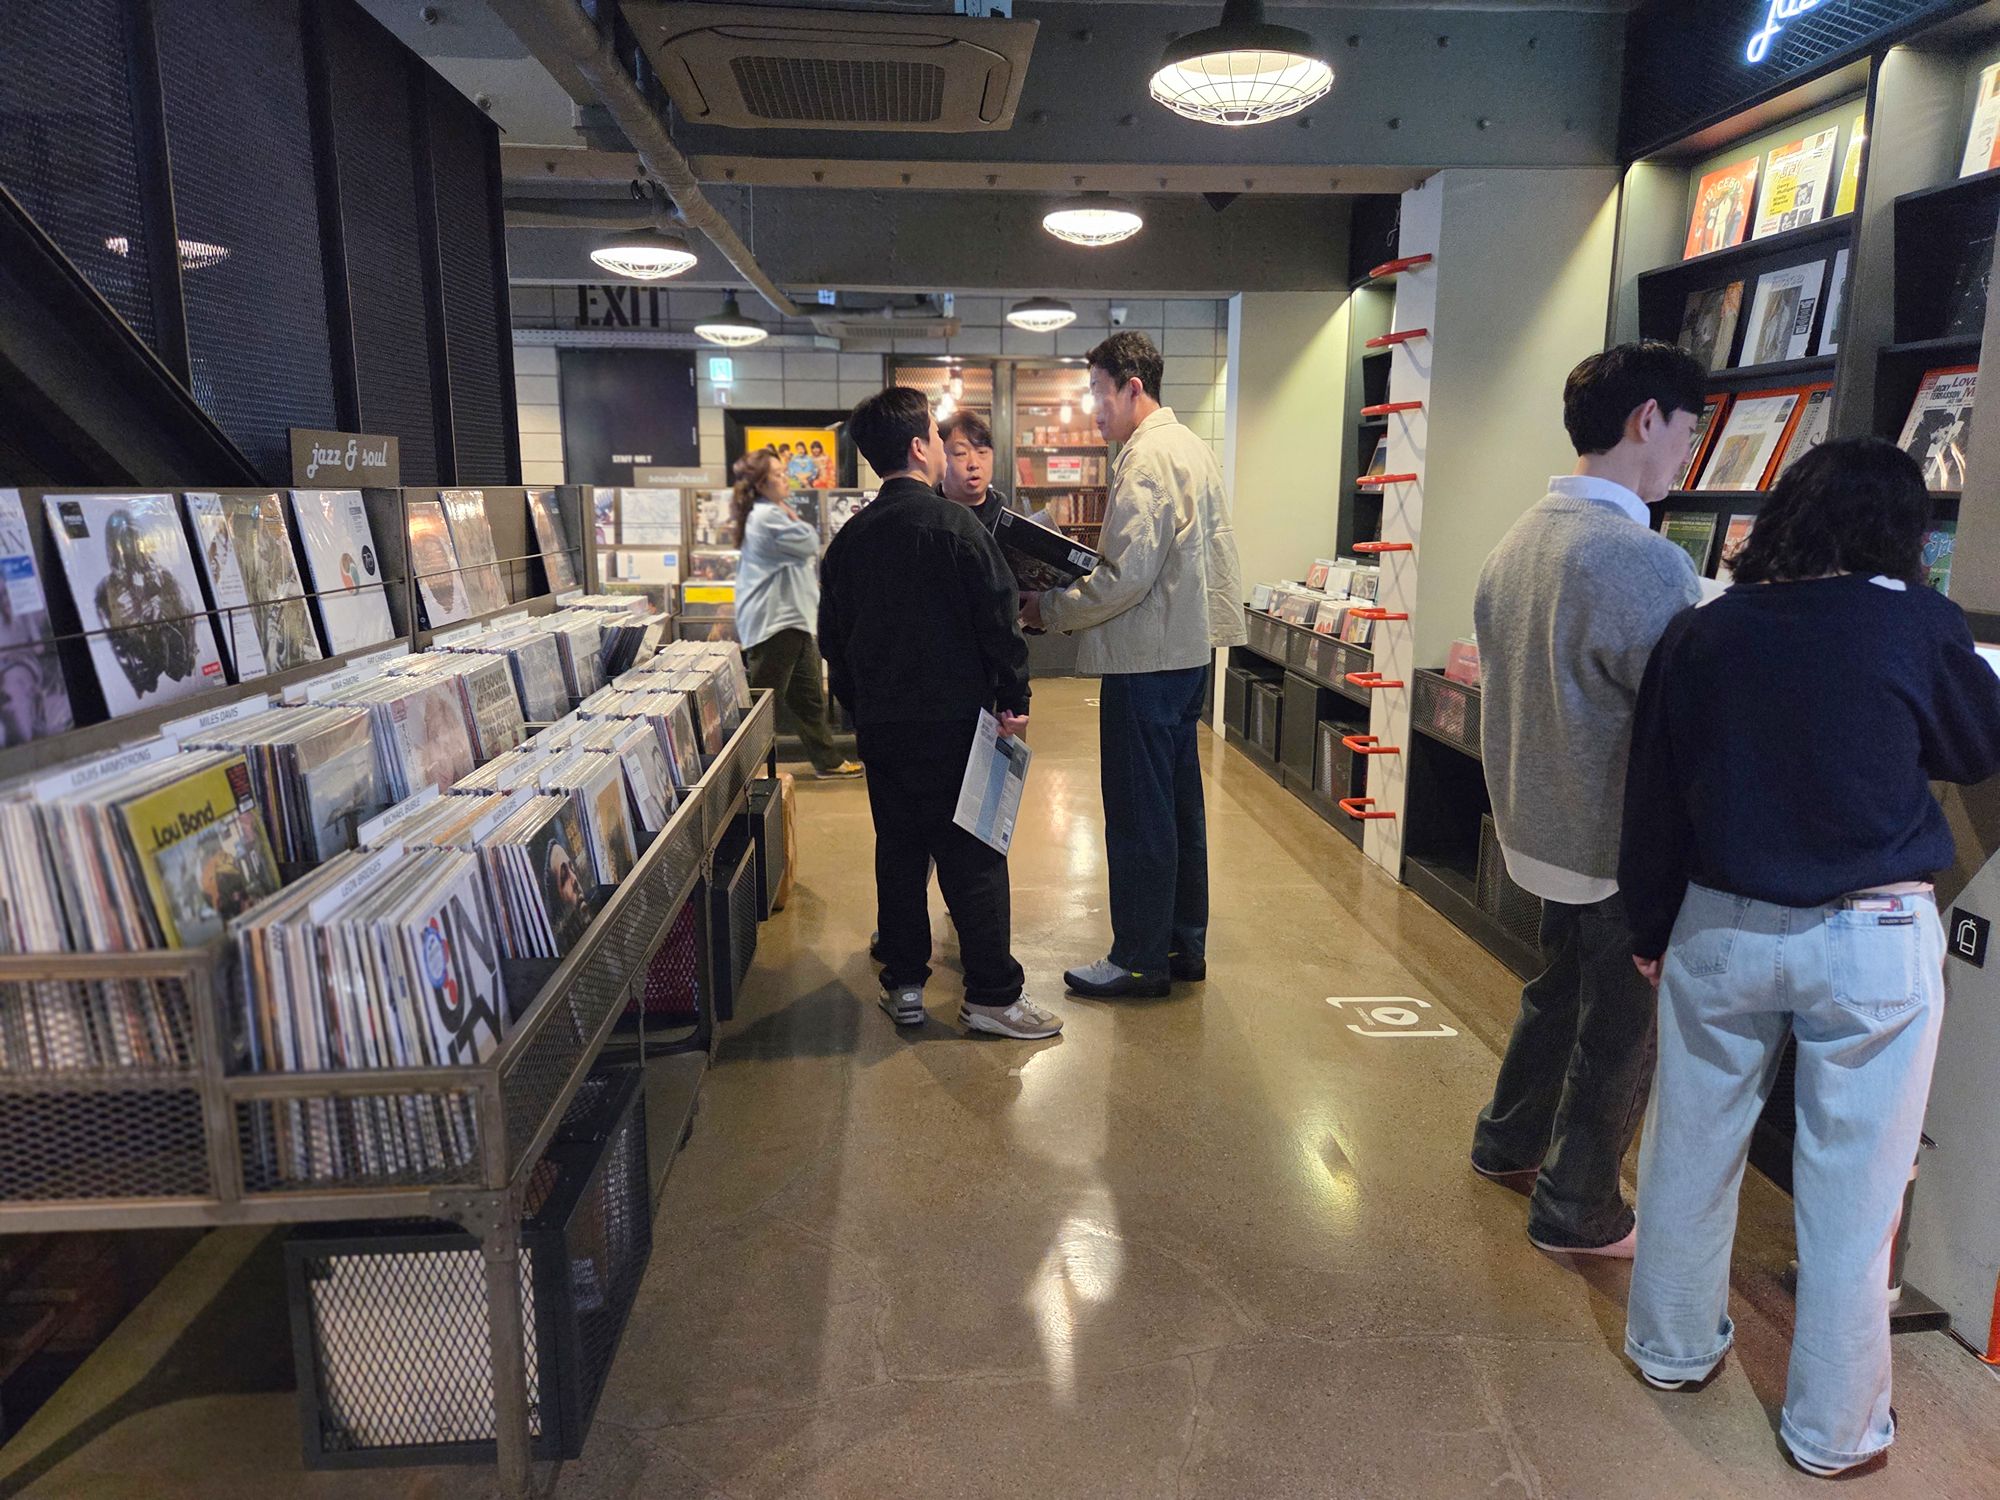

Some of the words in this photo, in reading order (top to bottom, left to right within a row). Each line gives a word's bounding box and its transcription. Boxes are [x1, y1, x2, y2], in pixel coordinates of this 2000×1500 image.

[578, 285, 667, 327] EXIT
[306, 442, 341, 479] jazz
[344, 439, 358, 471] &
[361, 441, 388, 467] soul
[199, 712, 219, 728] MILES
[219, 706, 239, 722] DAVIS
[71, 769, 98, 786] LOUIS
[99, 748, 151, 777] ARMSTRONG
[152, 824, 180, 849] Lou
[178, 800, 214, 836] Bond
[340, 879, 358, 897] LEON
[357, 858, 382, 886] BRIDGES
